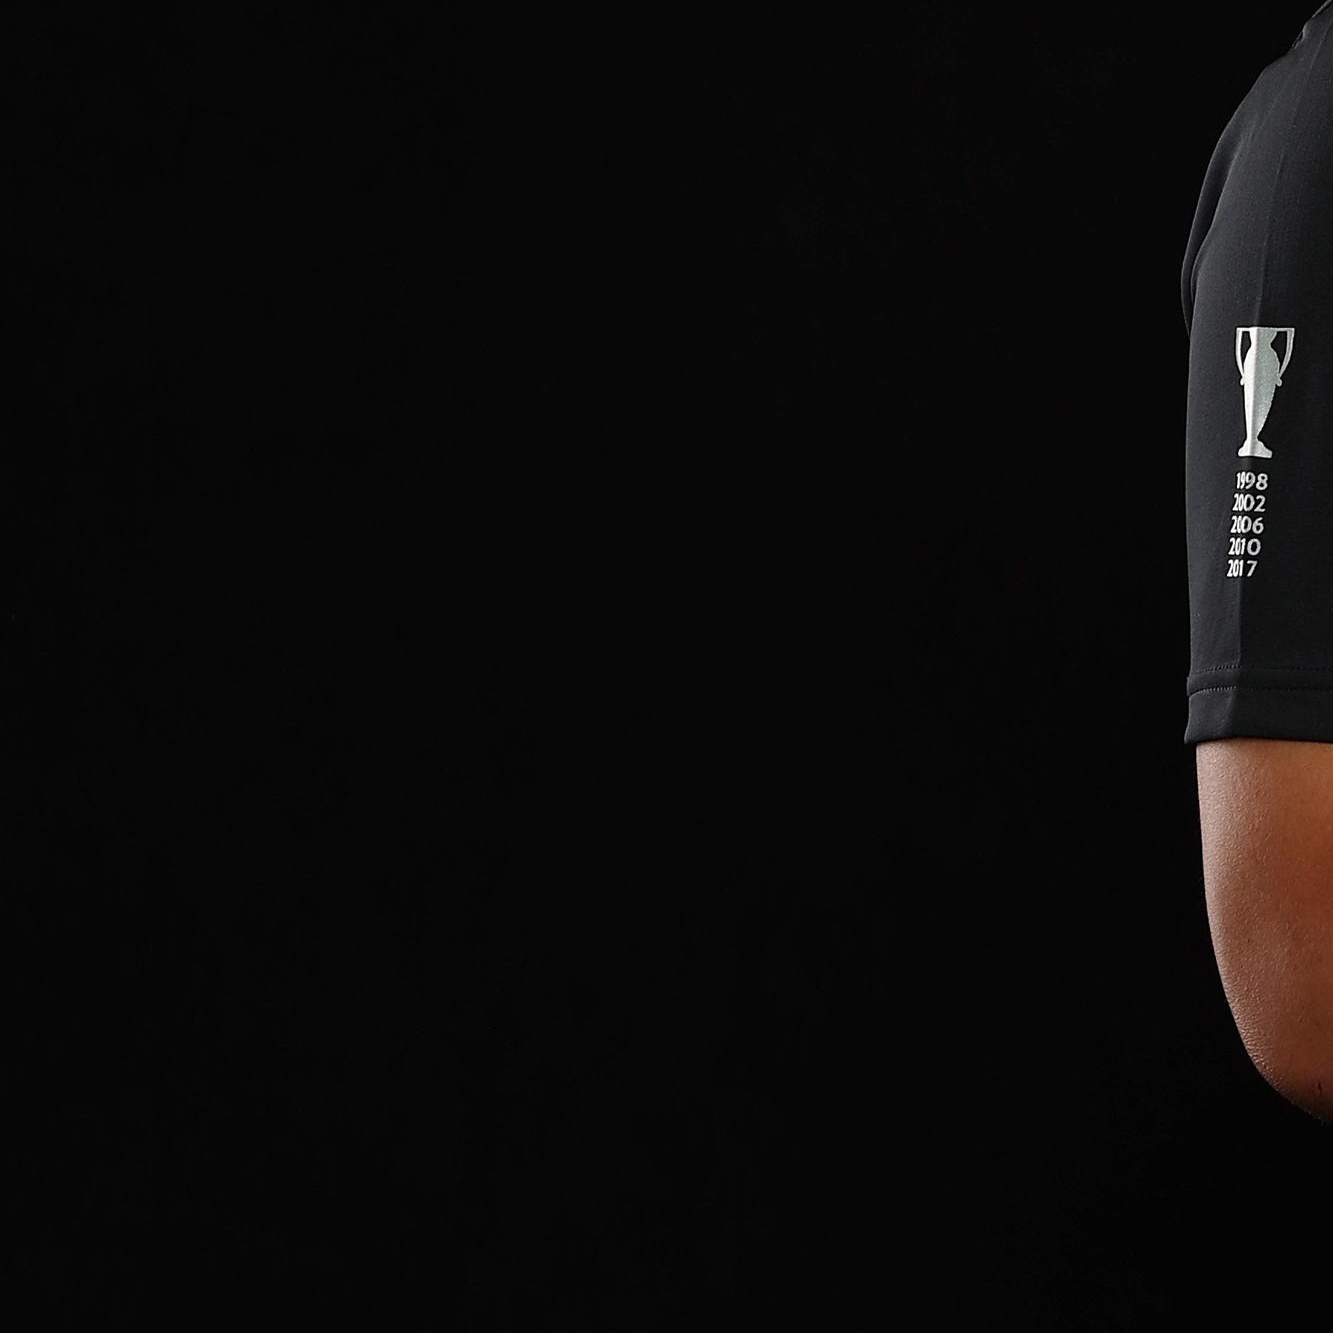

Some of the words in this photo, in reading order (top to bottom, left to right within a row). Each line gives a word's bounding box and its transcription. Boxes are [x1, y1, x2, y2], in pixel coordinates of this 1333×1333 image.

[1236, 471, 1268, 491] 1998
[1232, 493, 1266, 512] 2002
[1230, 515, 1264, 534] 2006
[1228, 537, 1261, 556] 2010
[1226, 559, 1258, 578] 2017
